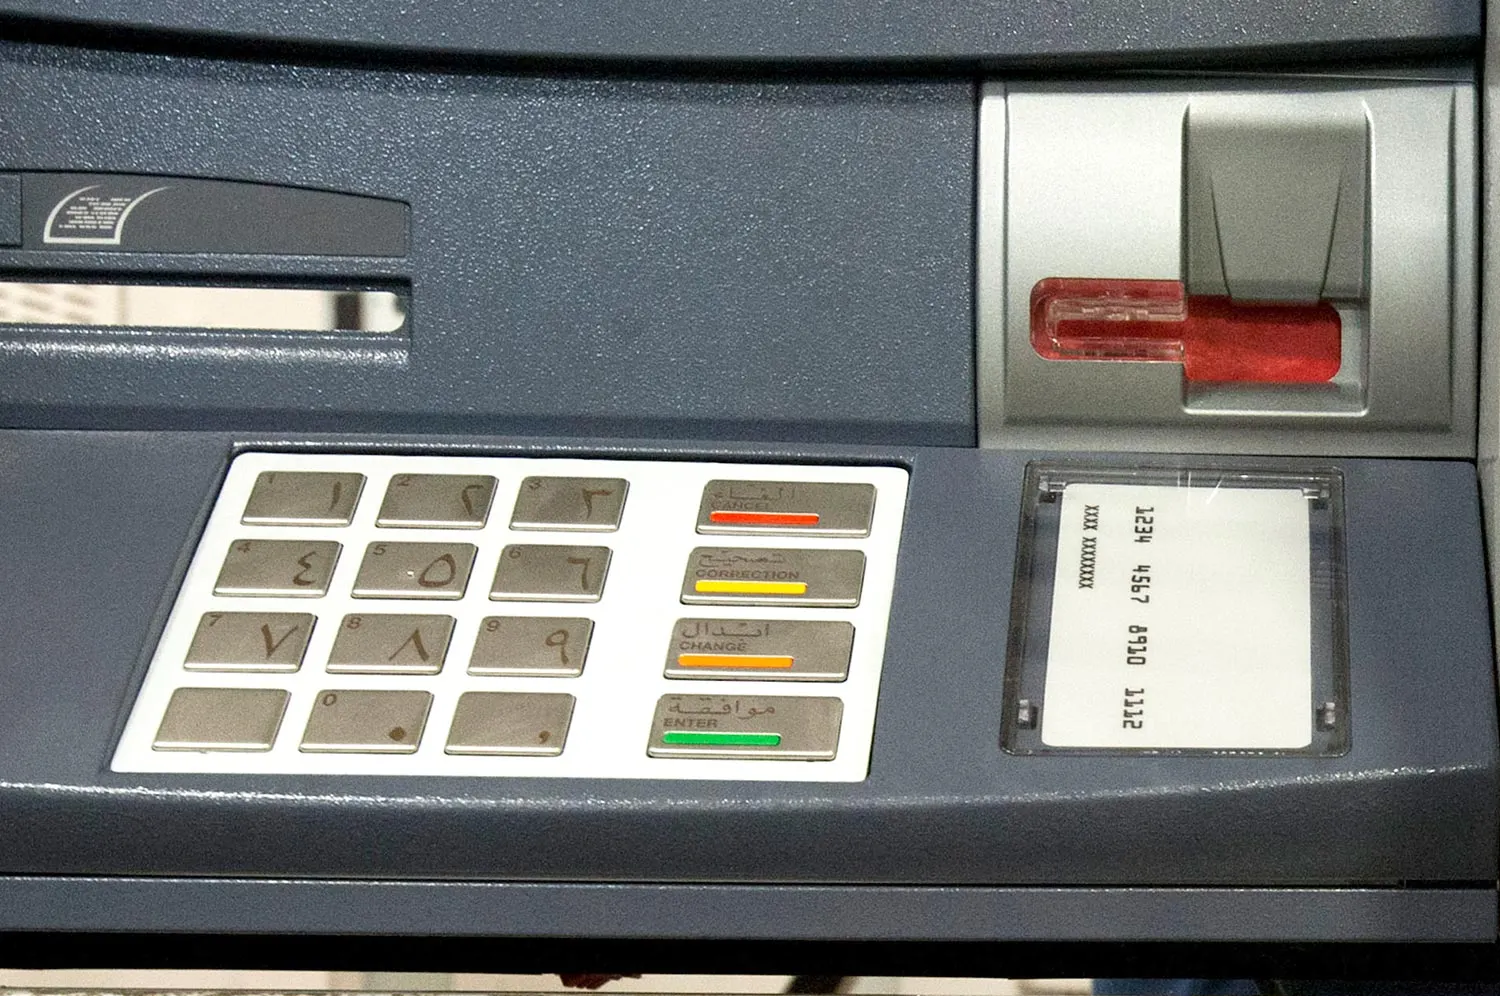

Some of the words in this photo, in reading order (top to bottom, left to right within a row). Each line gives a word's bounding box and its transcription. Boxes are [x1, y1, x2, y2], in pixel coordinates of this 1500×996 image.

[1083, 504, 1099, 531] XXXX
[1134, 505, 1155, 543] 1234
[695, 568, 800, 580] CORRECTION
[1130, 564, 1151, 604] 4567
[208, 614, 222, 627] 7
[347, 616, 362, 630] 8
[486, 619, 501, 632] 9
[679, 640, 749, 652] CHANGE
[1126, 624, 1148, 666] 8910
[1122, 687, 1145, 730] 1112
[662, 718, 719, 729] ENTER
